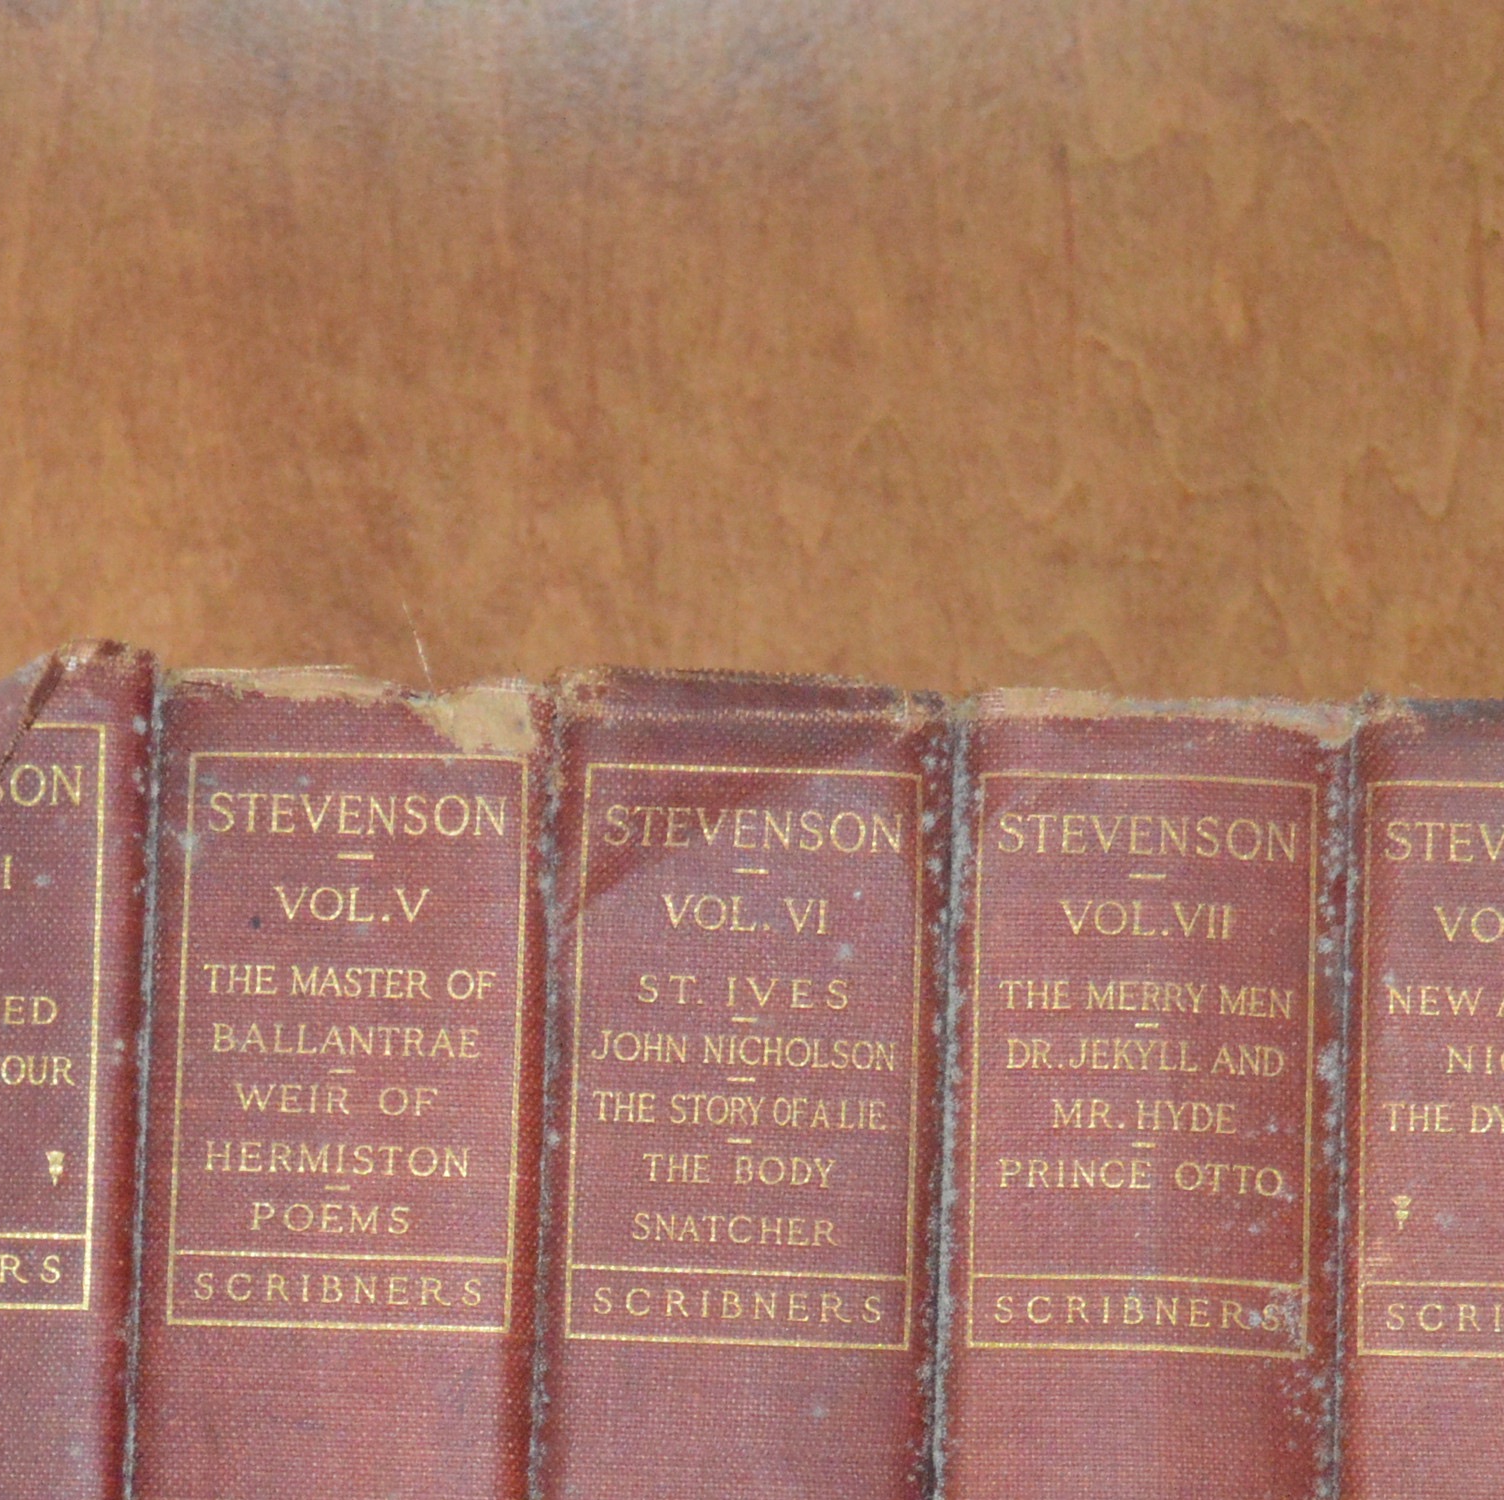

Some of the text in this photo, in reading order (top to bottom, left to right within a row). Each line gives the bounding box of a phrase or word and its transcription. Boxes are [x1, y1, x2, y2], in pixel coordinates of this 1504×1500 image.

[209, 792, 506, 838] STEVENSON
[604, 805, 904, 851] STEVENSON
[998, 813, 1297, 863] STEVENSON
[662, 893, 828, 935] VOL. VI
[203, 963, 495, 999] THE MASTER OF
[637, 975, 849, 1011] ST. IVES
[999, 979, 1292, 1017] THE MERRY MEN
[1386, 986, 1483, 1016] NEW
[213, 1023, 481, 1060] BALLANTRAE
[592, 1029, 896, 1071] JOHN NICHOLSON
[1212, 1045, 1285, 1077] AND
[235, 1081, 437, 1117] WEIR OF
[593, 1090, 657, 1124] THE
[669, 1094, 763, 1126] STORY
[1051, 1100, 1236, 1136] MR. HYDE
[1384, 1102, 1453, 1133] THE
[205, 1142, 470, 1178] HERMISTON
[643, 1154, 835, 1187] THE BODY
[999, 1158, 1284, 1197] PRINCE OTTO
[250, 1202, 410, 1235] POEMS
[632, 1213, 839, 1247] SNATCHER
[194, 1272, 484, 1307] SCRIBNERS
[593, 1287, 883, 1323] SCRIBNERS
[994, 1295, 1284, 1332] SCRIBNERS
